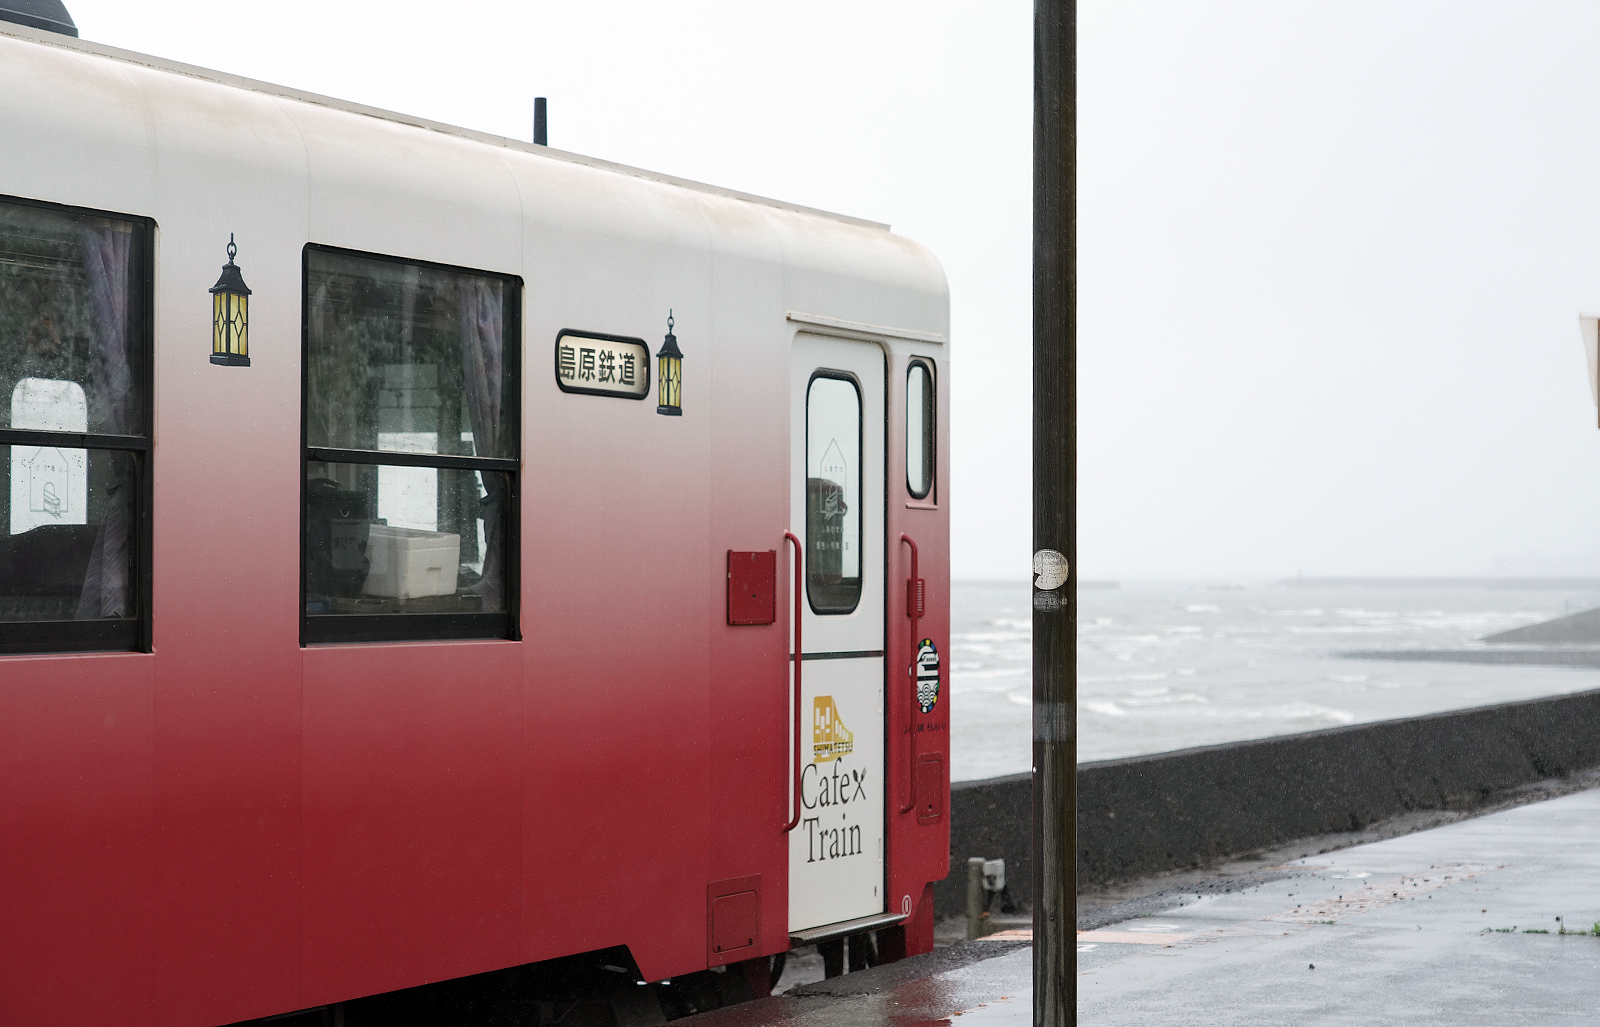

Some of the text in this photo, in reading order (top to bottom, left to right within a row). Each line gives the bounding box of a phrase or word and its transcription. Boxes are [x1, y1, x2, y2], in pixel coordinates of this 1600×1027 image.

[560, 345, 635, 386] 島原鉄道
[803, 813, 862, 863] Train
